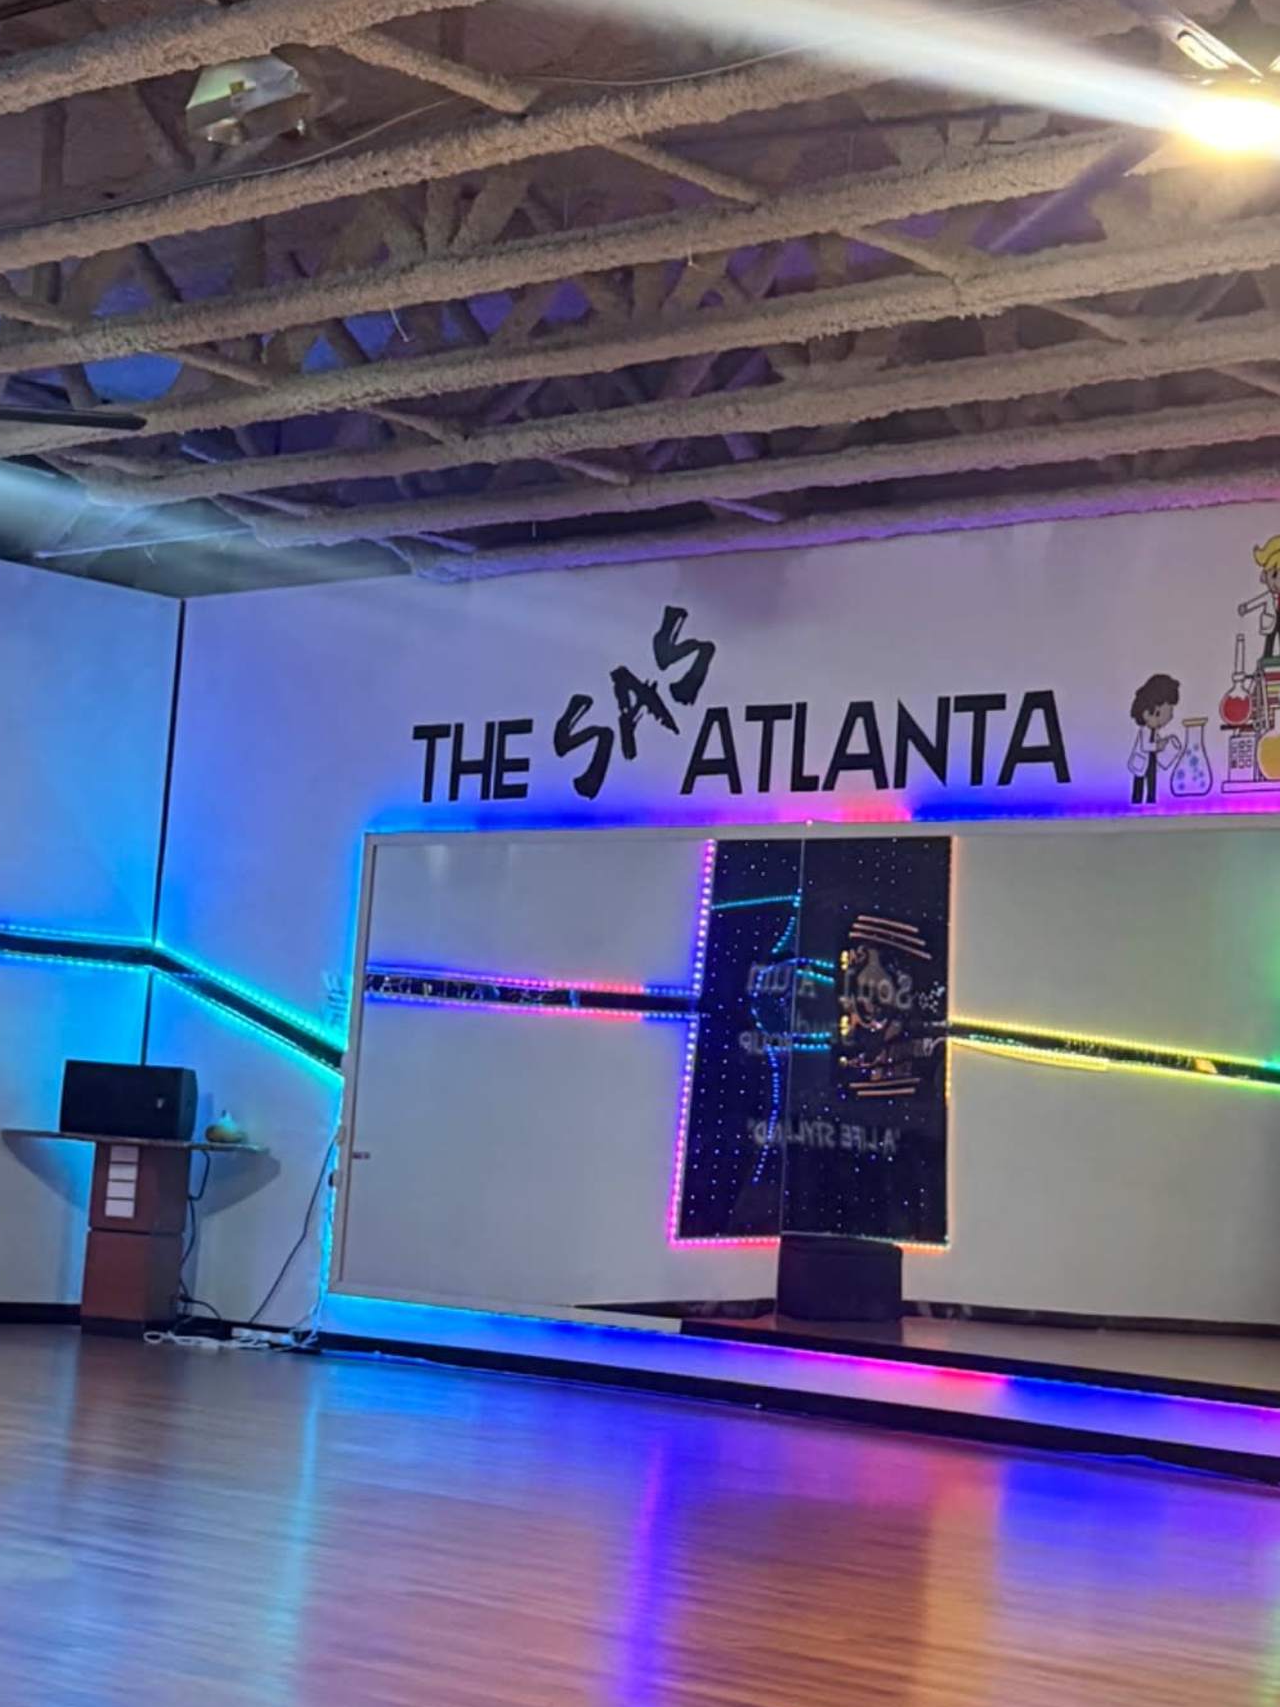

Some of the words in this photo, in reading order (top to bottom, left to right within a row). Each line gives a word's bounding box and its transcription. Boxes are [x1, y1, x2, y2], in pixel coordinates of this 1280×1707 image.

[412, 718, 533, 803] THE
[553, 605, 716, 800] SAS
[680, 689, 1072, 795] ATLANTA
